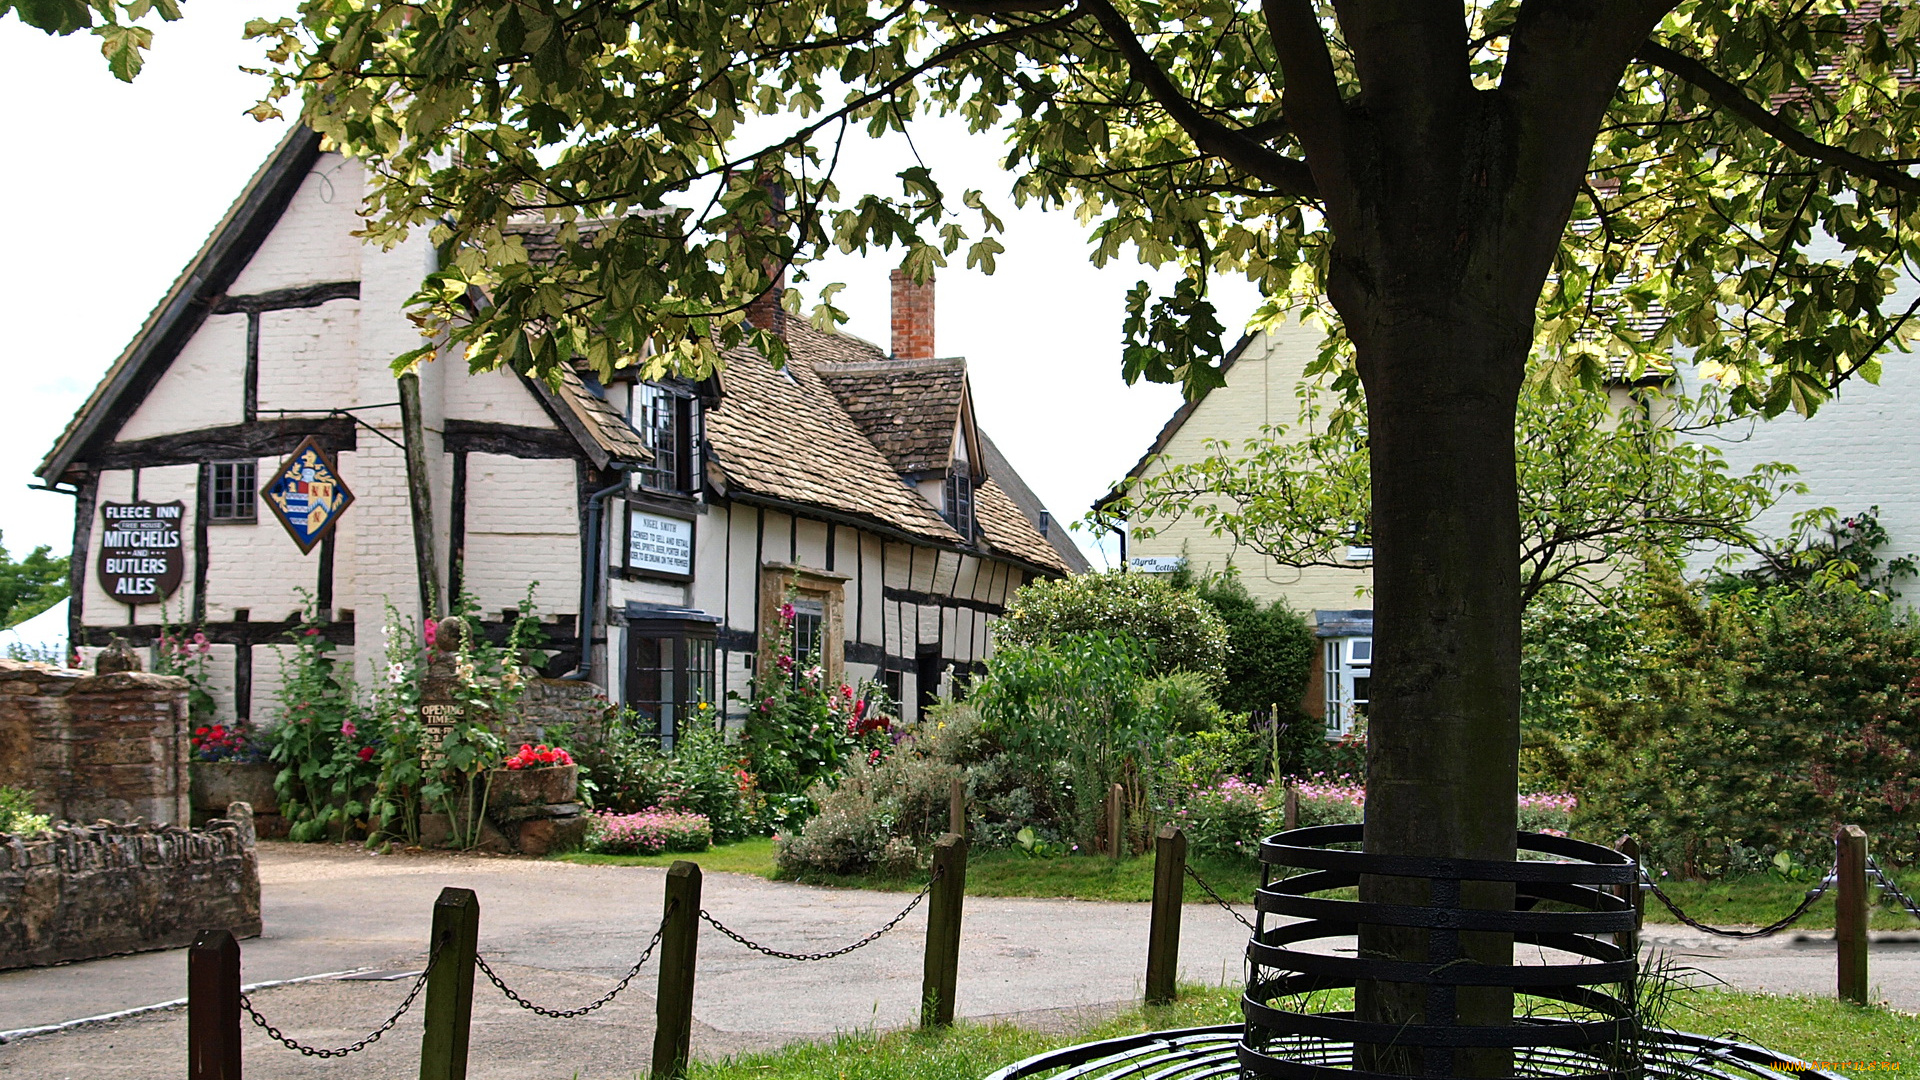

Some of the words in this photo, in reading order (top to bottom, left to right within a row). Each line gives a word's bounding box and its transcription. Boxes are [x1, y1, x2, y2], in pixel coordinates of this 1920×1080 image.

[106, 506, 151, 519] FLEECE
[156, 506, 180, 518] INN
[643, 518, 658, 529] NIGEL
[660, 522, 676, 532] SMITH
[104, 530, 180, 548] MITCHELLS
[649, 533, 656, 542] TO
[666, 536, 675, 546] AND
[131, 549, 149, 557] AND
[680, 549, 689, 558] AND
[105, 558, 168, 574] BUTLERS
[115, 577, 156, 595] ALES
